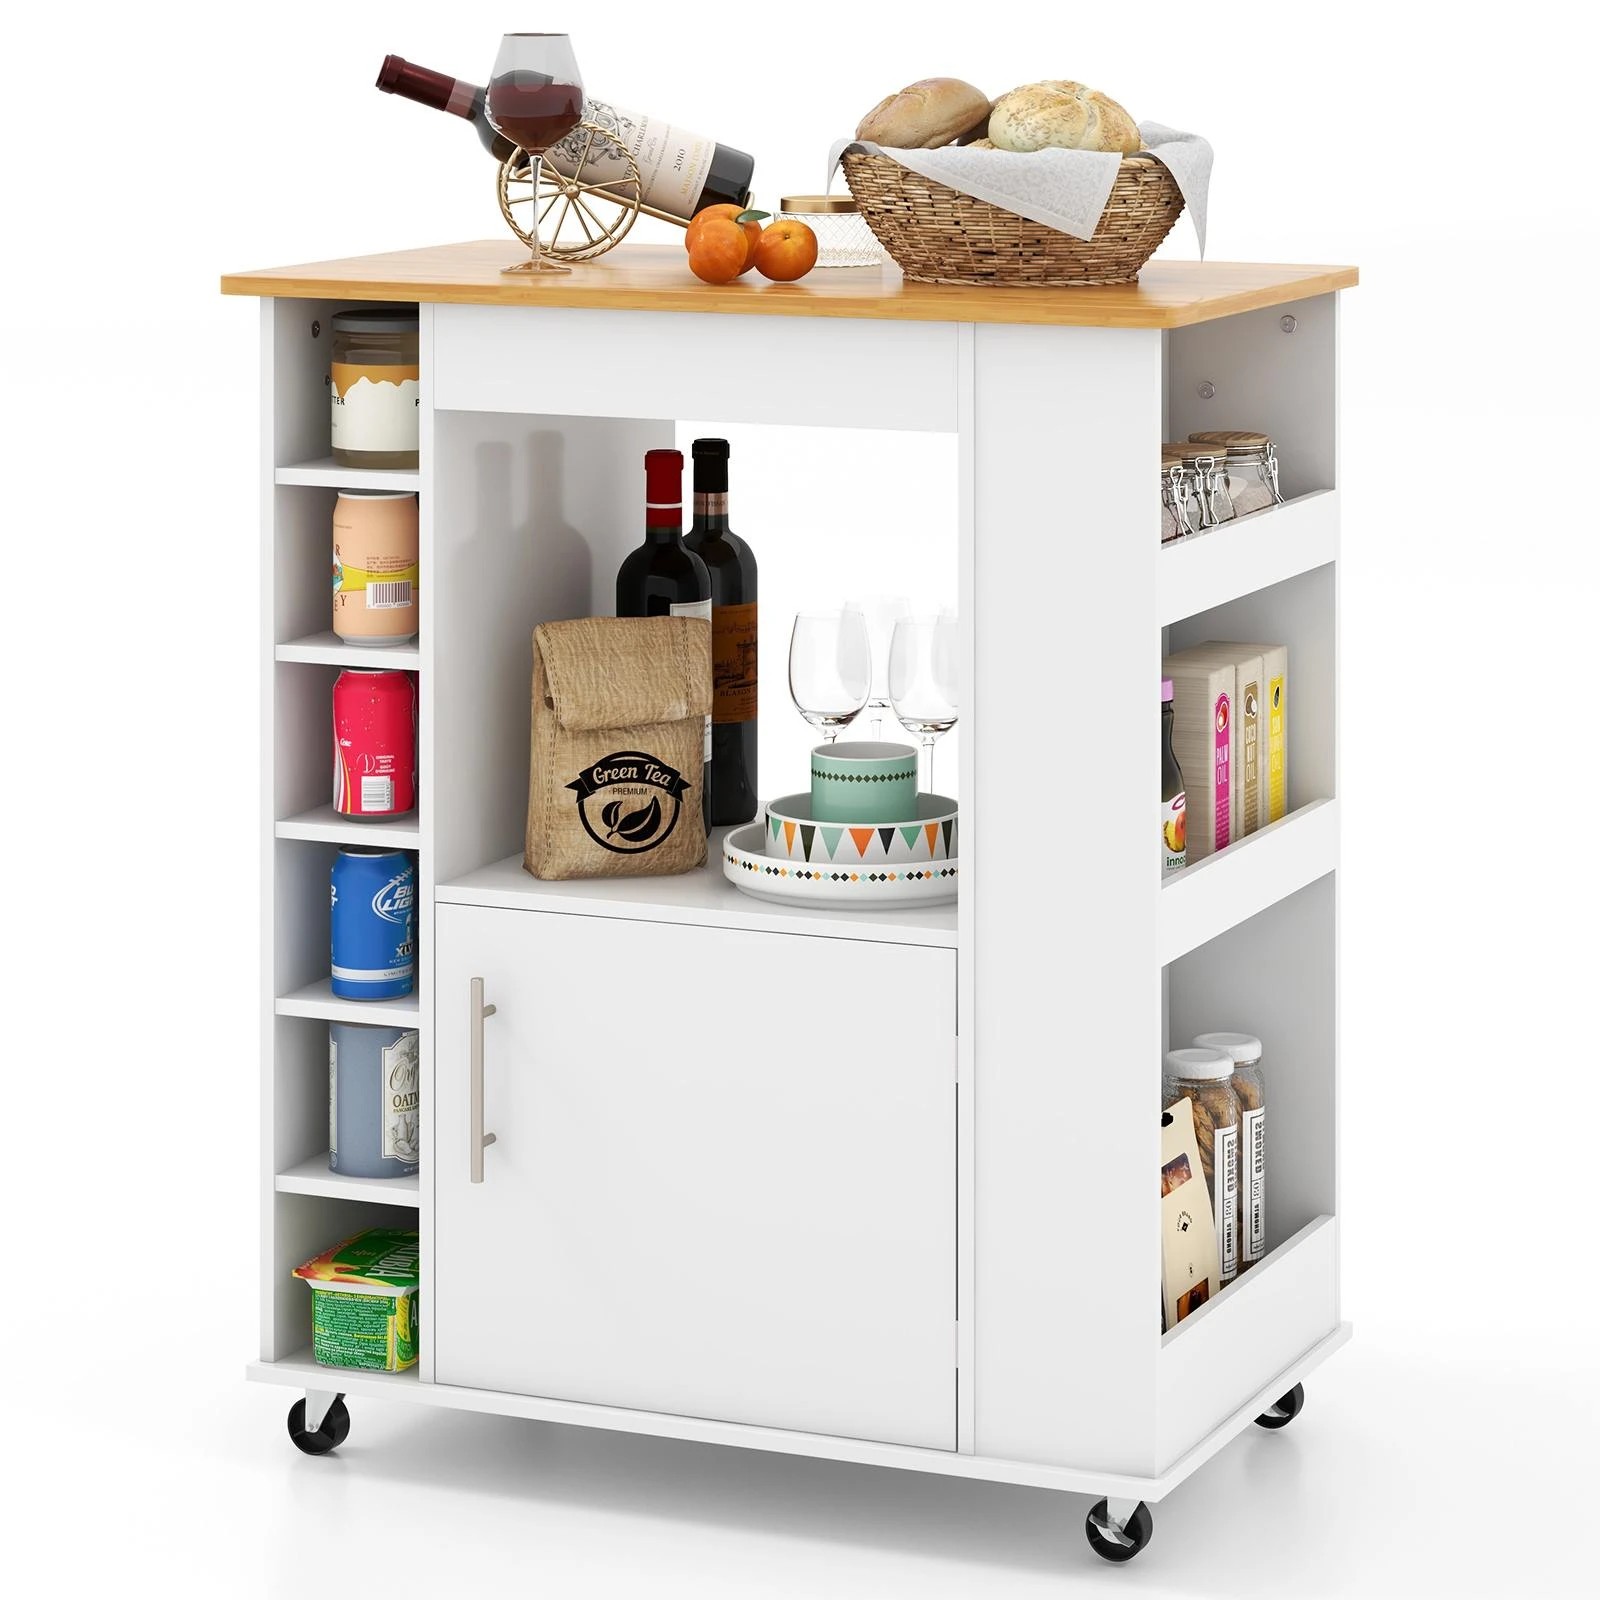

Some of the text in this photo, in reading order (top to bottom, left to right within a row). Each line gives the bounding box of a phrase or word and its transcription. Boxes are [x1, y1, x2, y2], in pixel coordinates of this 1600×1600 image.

[673, 148, 687, 172] 2010
[1216, 744, 1229, 766] PALM
[593, 763, 671, 786] Green Tea
[1217, 764, 1228, 785] OIL
[612, 787, 648, 795] PREMIUM
[393, 884, 414, 899] BU
[382, 897, 414, 912] LIG
